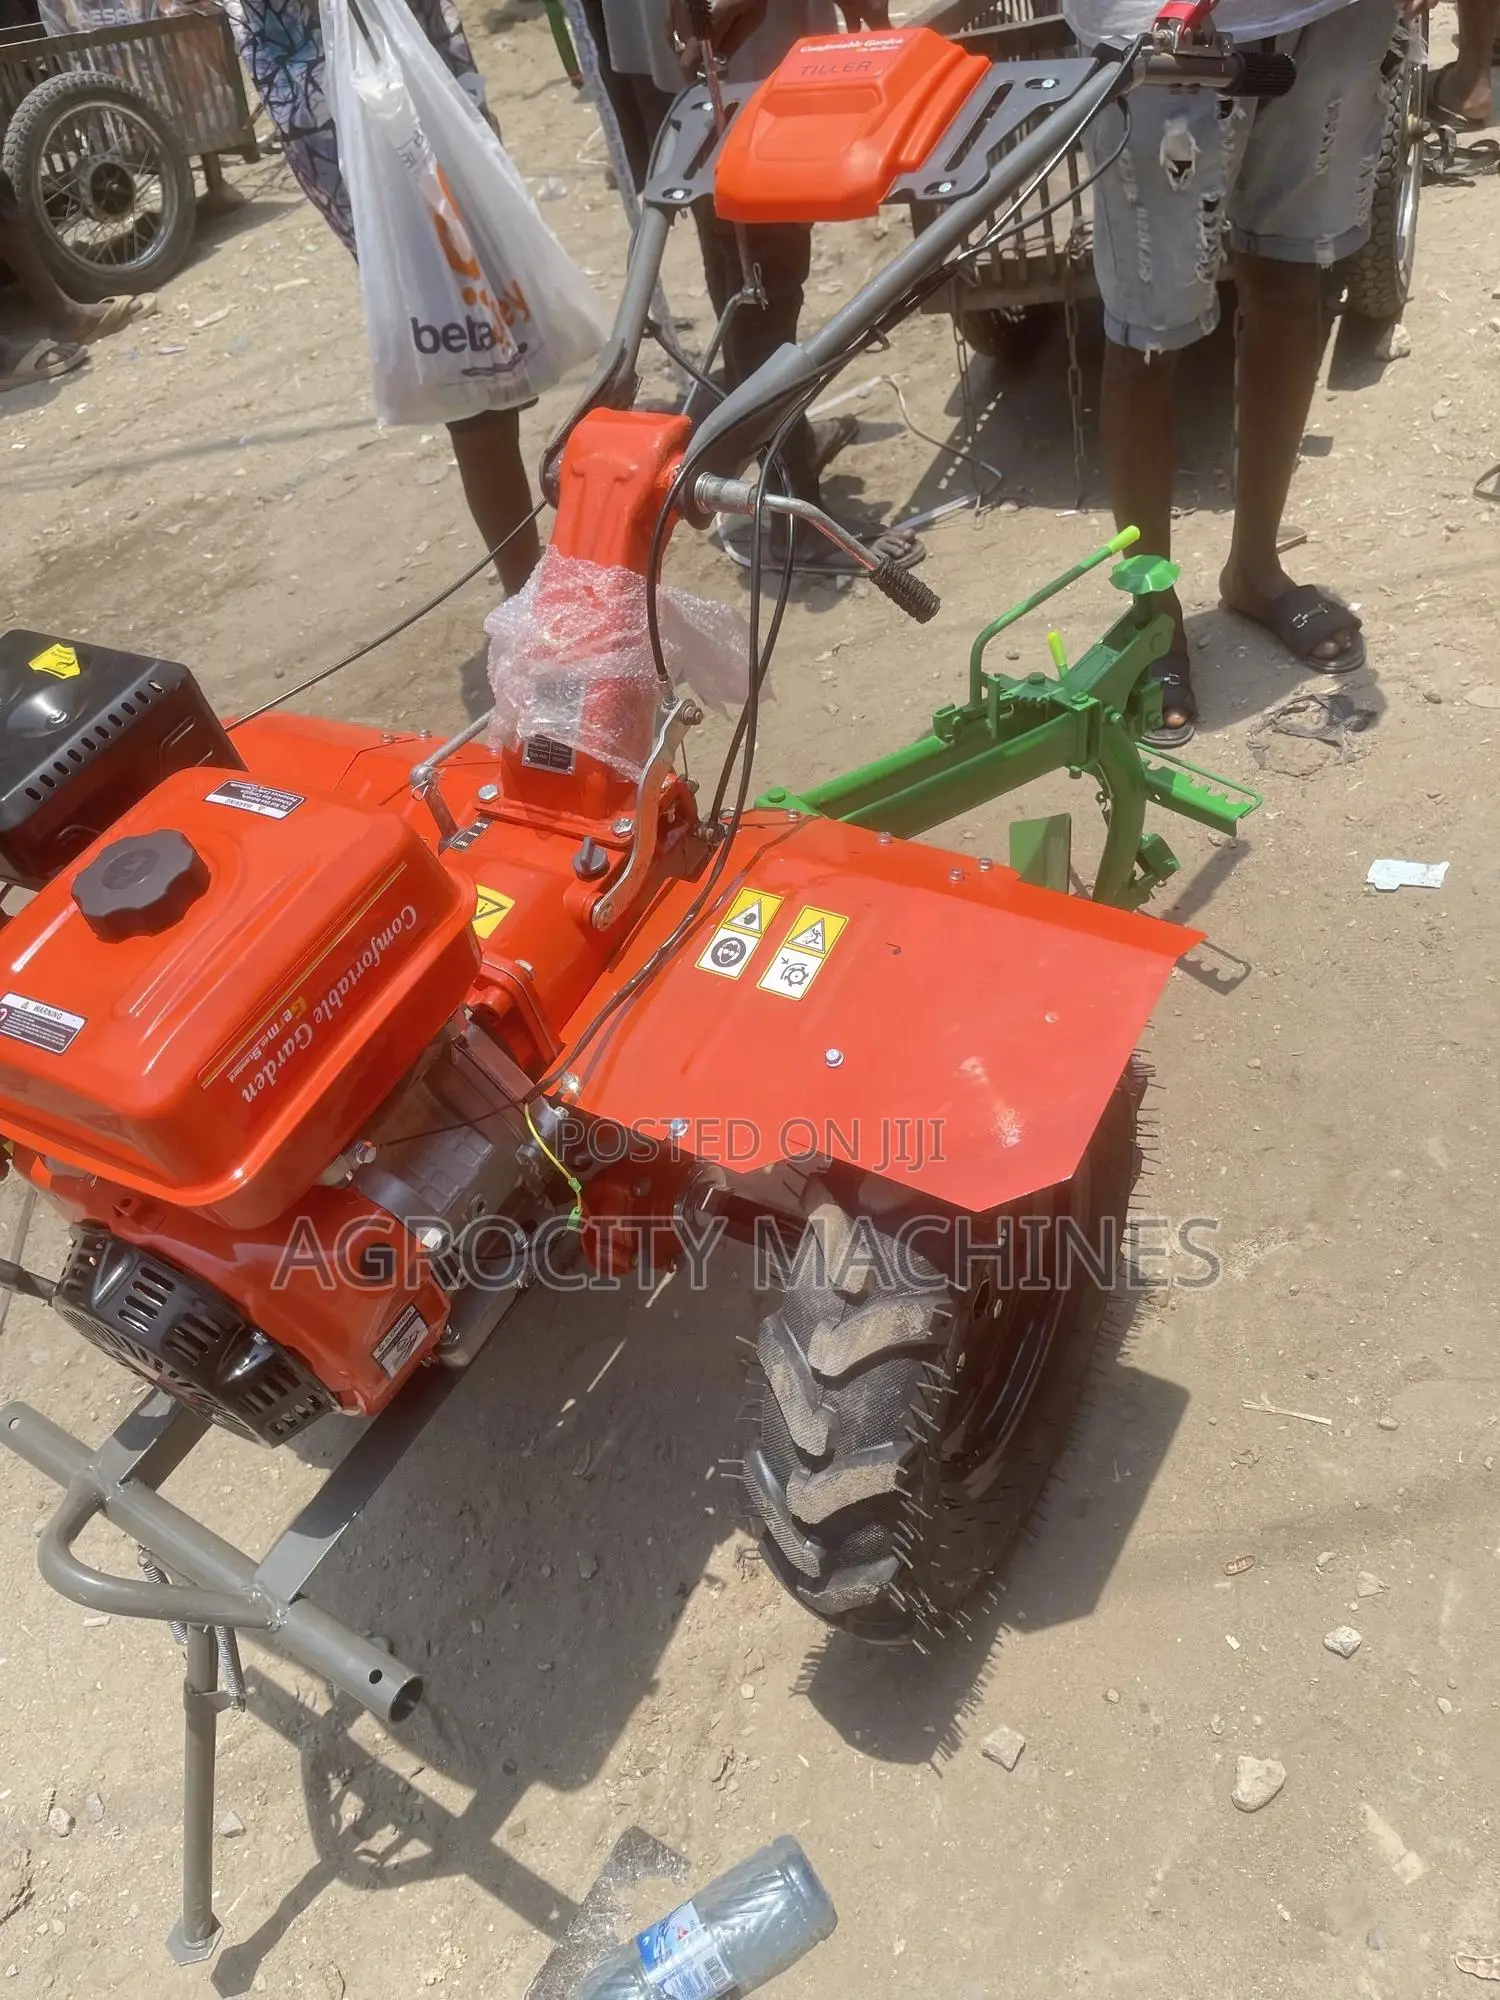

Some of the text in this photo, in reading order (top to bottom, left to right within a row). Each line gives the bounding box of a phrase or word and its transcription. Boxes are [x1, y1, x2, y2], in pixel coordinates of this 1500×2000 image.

[801, 60, 873, 76] TILLER
[241, 904, 417, 1103] Comfortable Garden
[33, 1004, 64, 1020] WARNING
